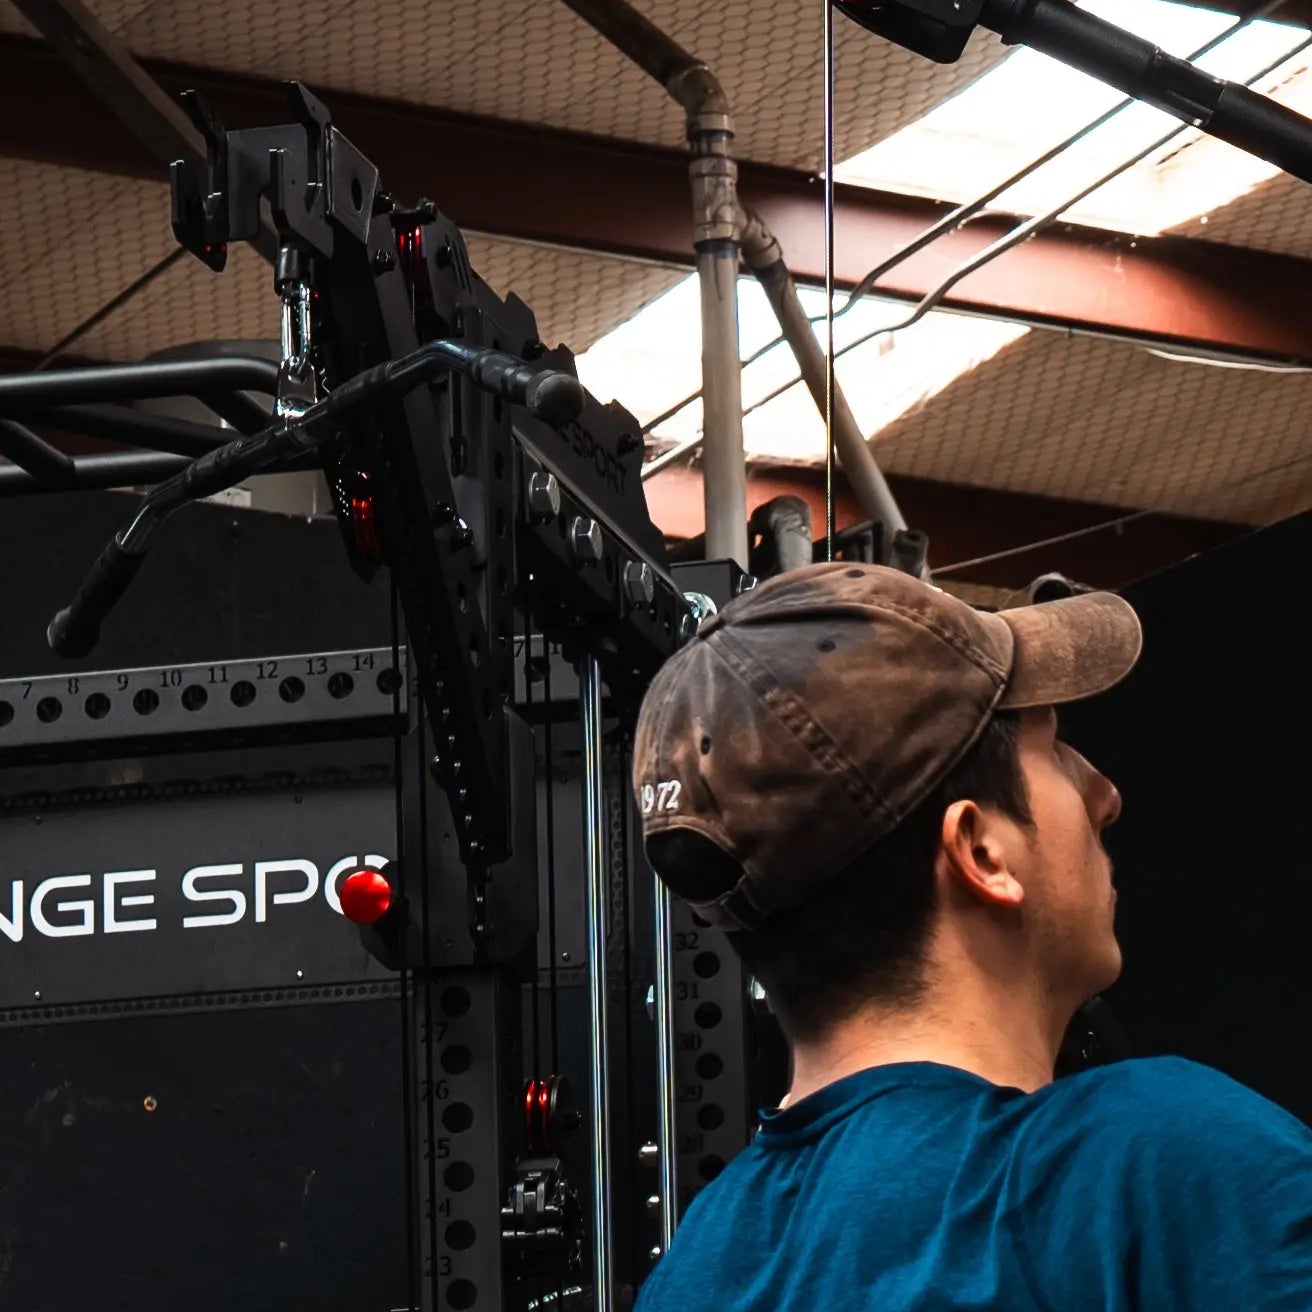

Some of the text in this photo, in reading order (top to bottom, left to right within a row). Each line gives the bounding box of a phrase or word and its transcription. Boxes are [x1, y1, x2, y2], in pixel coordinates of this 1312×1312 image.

[256, 662, 279, 679] 12
[306, 657, 328, 675] 13
[352, 654, 375, 671] 14
[117, 674, 129, 690] 9
[160, 670, 182, 687] 10
[207, 666, 229, 683] 11
[22, 682, 33, 699] 7
[67, 677, 80, 694] 8
